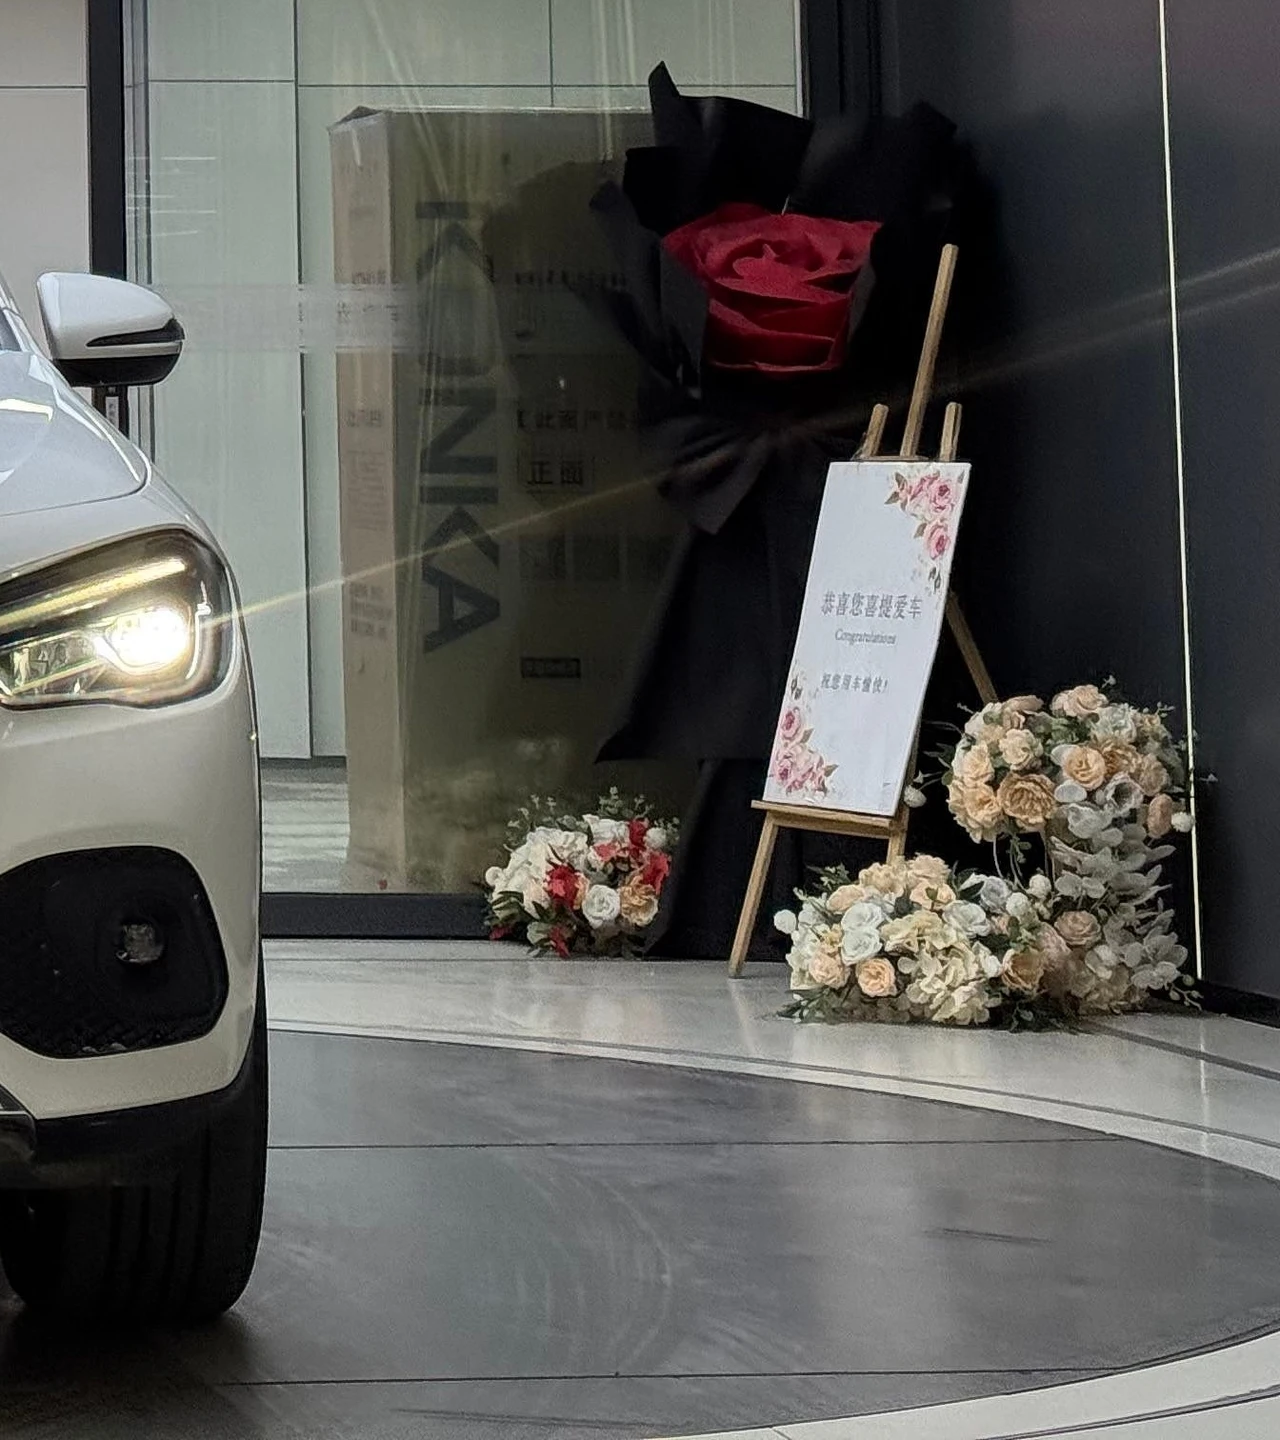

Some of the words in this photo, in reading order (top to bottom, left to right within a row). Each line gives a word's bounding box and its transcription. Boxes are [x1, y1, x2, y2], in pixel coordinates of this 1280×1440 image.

[821, 590, 924, 620] 恭喜您喜提爱车
